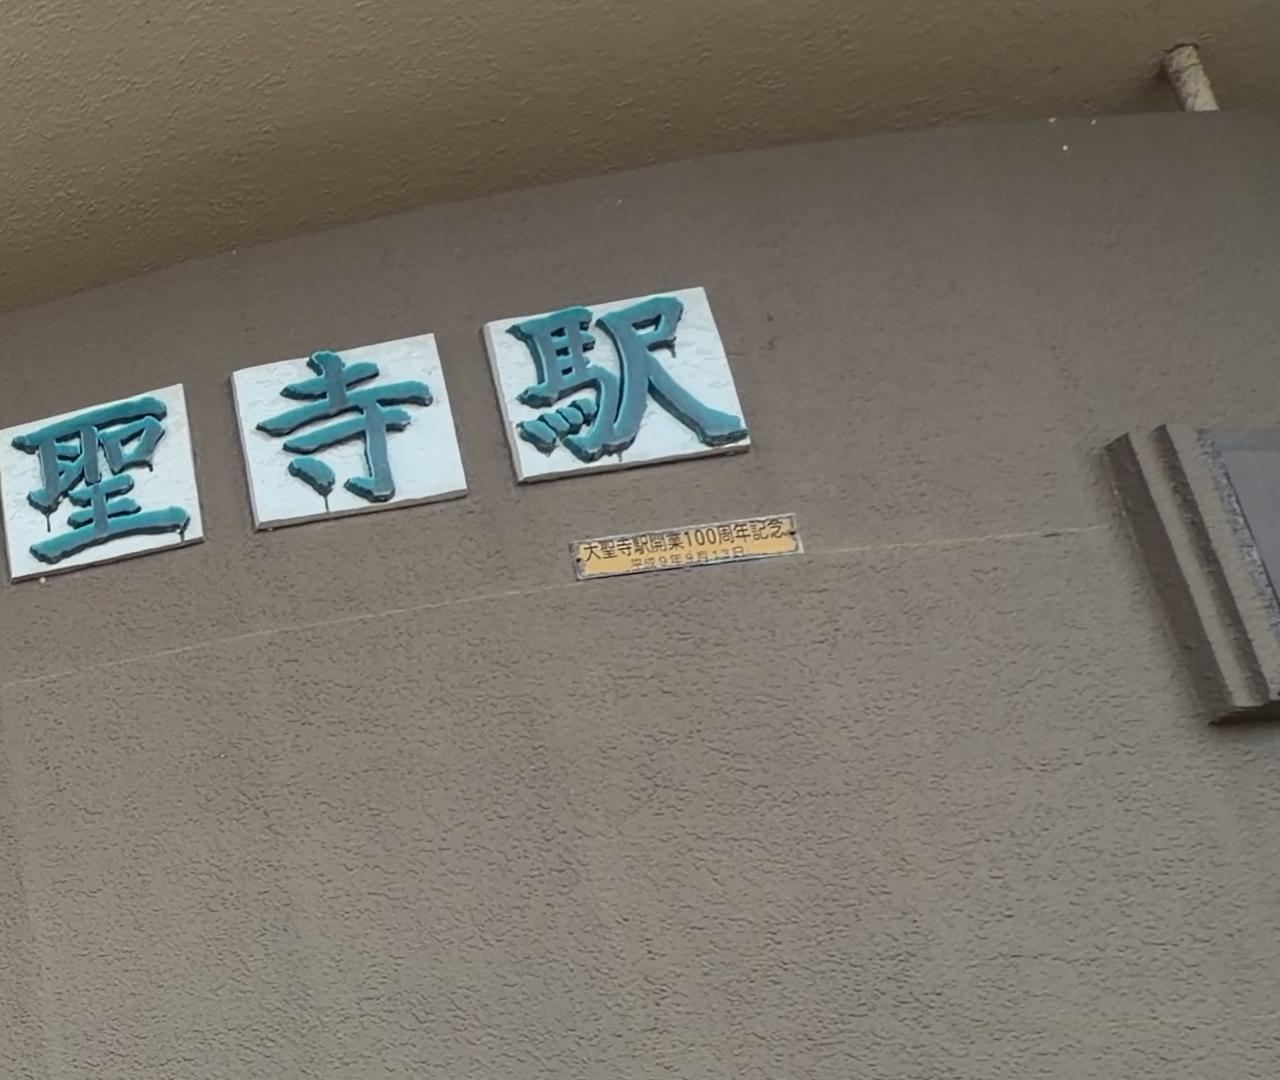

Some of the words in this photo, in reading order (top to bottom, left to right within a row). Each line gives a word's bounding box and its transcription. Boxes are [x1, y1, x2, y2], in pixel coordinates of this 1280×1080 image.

[583, 519, 787, 561] 大聖寺駅開業100周年記念
